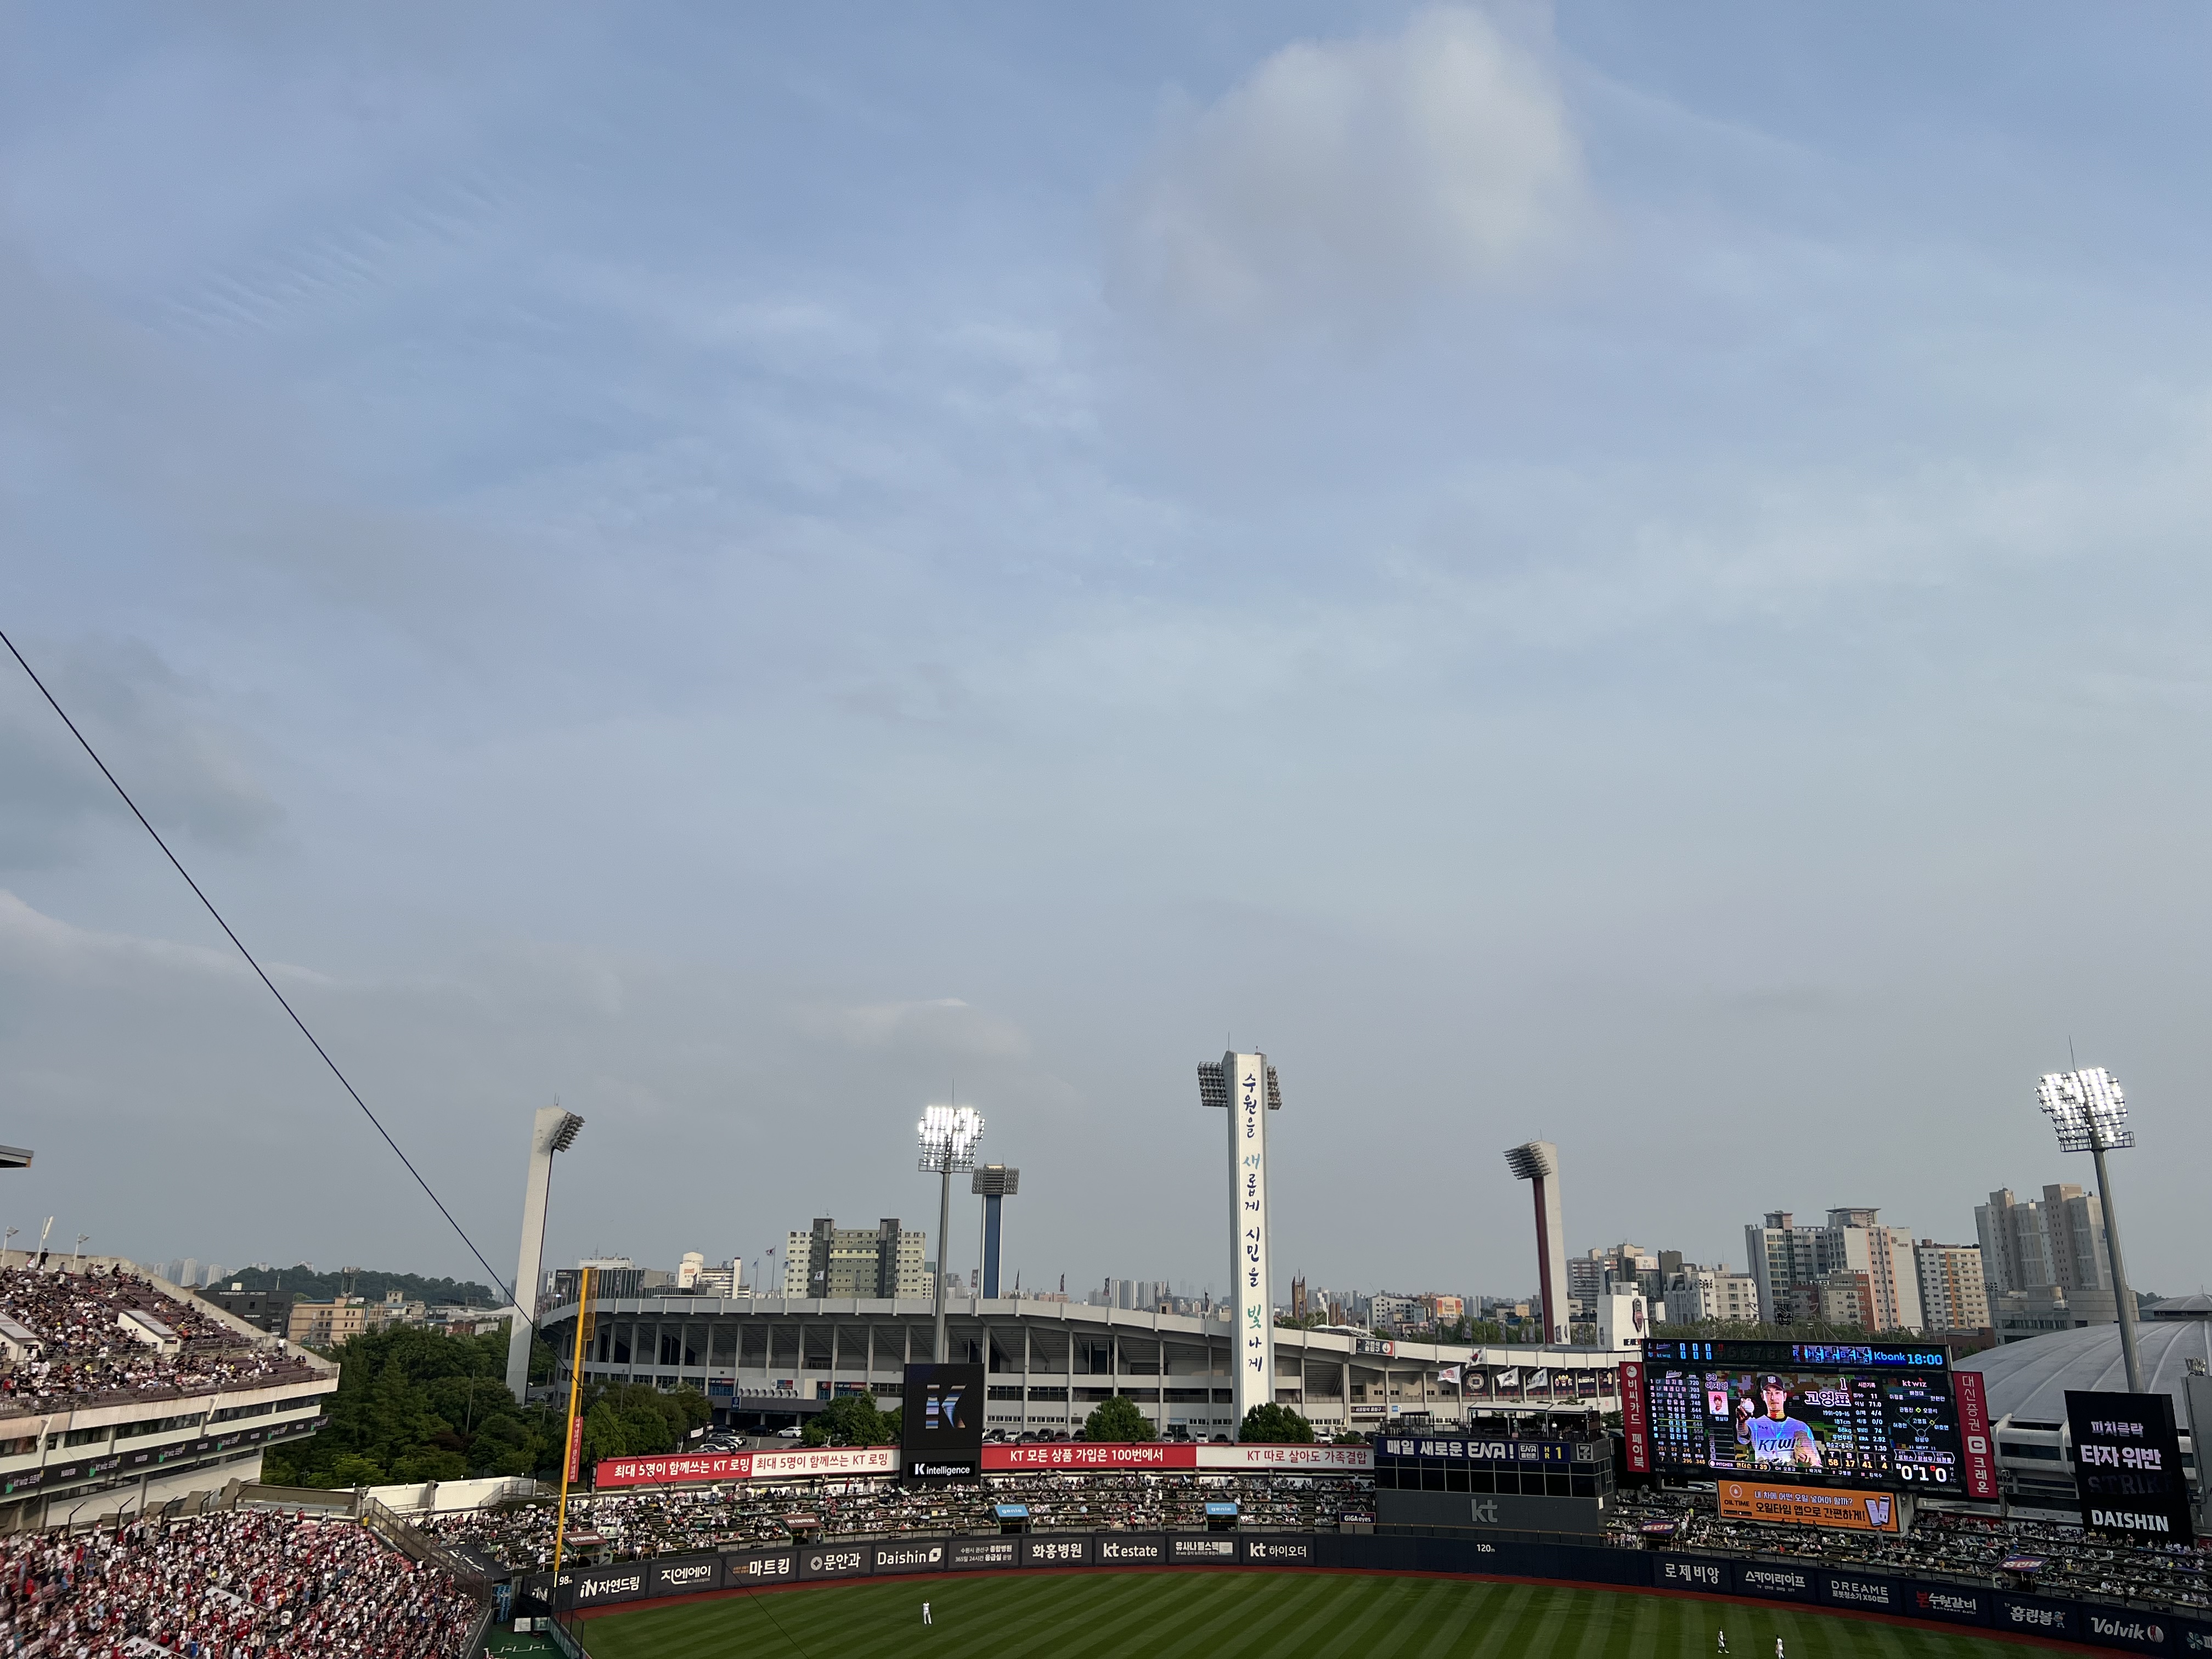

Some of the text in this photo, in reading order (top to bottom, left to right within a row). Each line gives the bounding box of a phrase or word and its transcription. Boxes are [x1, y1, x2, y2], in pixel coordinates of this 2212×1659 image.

[1242, 1073, 1262, 1372] 수원을 새롭게 시민을 빛나게
[1874, 1351, 1906, 1361] Kbank
[1907, 1353, 1943, 1365] 18:00
[1706, 1373, 1717, 1381] 59
[1839, 1378, 1848, 1390] 1
[1705, 1381, 1728, 1390] 이지영
[1804, 1391, 1852, 1407] 고영표
[1628, 1379, 1644, 1468] 비씨카드 페이북
[2091, 1420, 2144, 1438] 피치클락
[1962, 1375, 1989, 1493] 대신증권 크레온
[1010, 1448, 1164, 1463] KT 모든 상품 가입은 100번에서
[1386, 1440, 1463, 1457] 매일 새로운
[1555, 1446, 1562, 1459] 1
[757, 1453, 888, 1470] 최대 5명이 함께쓰는 KT 로밍
[1247, 1450, 1368, 1464] KT 따로 살아도 가족결합
[2080, 1444, 2162, 1470] 타자 위반
[60, 1468, 76, 1477] NAVER
[614, 1458, 750, 1479] 최대 5명이 함께쓰는 KT 로밍
[915, 1463, 970, 1476] K intelligence
[1901, 1465, 1912, 1480] 0
[1918, 1466, 1929, 1481] 1
[1935, 1468, 1947, 1482] 0
[1754, 1490, 1762, 1498] 내
[1763, 1491, 1778, 1500] 차에
[1779, 1492, 1793, 1502] 어떤
[1795, 1493, 1809, 1503] 오일
[1833, 1496, 1854, 1506] 할까?
[1470, 1499, 1498, 1522] kt
[1756, 1502, 1866, 1522] 오일타임 앱으로 간편하게!
[2091, 1509, 2169, 1532] DAISHIN
[990, 1544, 1013, 1553] 종합병원
[1032, 1543, 1082, 1560] 화홍병원
[1103, 1543, 1158, 1558] kt estate
[1249, 1542, 1307, 1558] kt 하이오더
[823, 1552, 861, 1571] 문안과
[877, 1550, 927, 1565] Daishin
[985, 1553, 1002, 1562] 응급실
[748, 1557, 790, 1576] 마트킹
[1664, 1563, 1720, 1584] 로제비앙
[1745, 1570, 1806, 1588] 스카이라이프
[1831, 1580, 1888, 1596] DREAME
[1832, 1590, 1877, 1602] 로봇청소기 X50
[2091, 1617, 2145, 1640] Volvik
